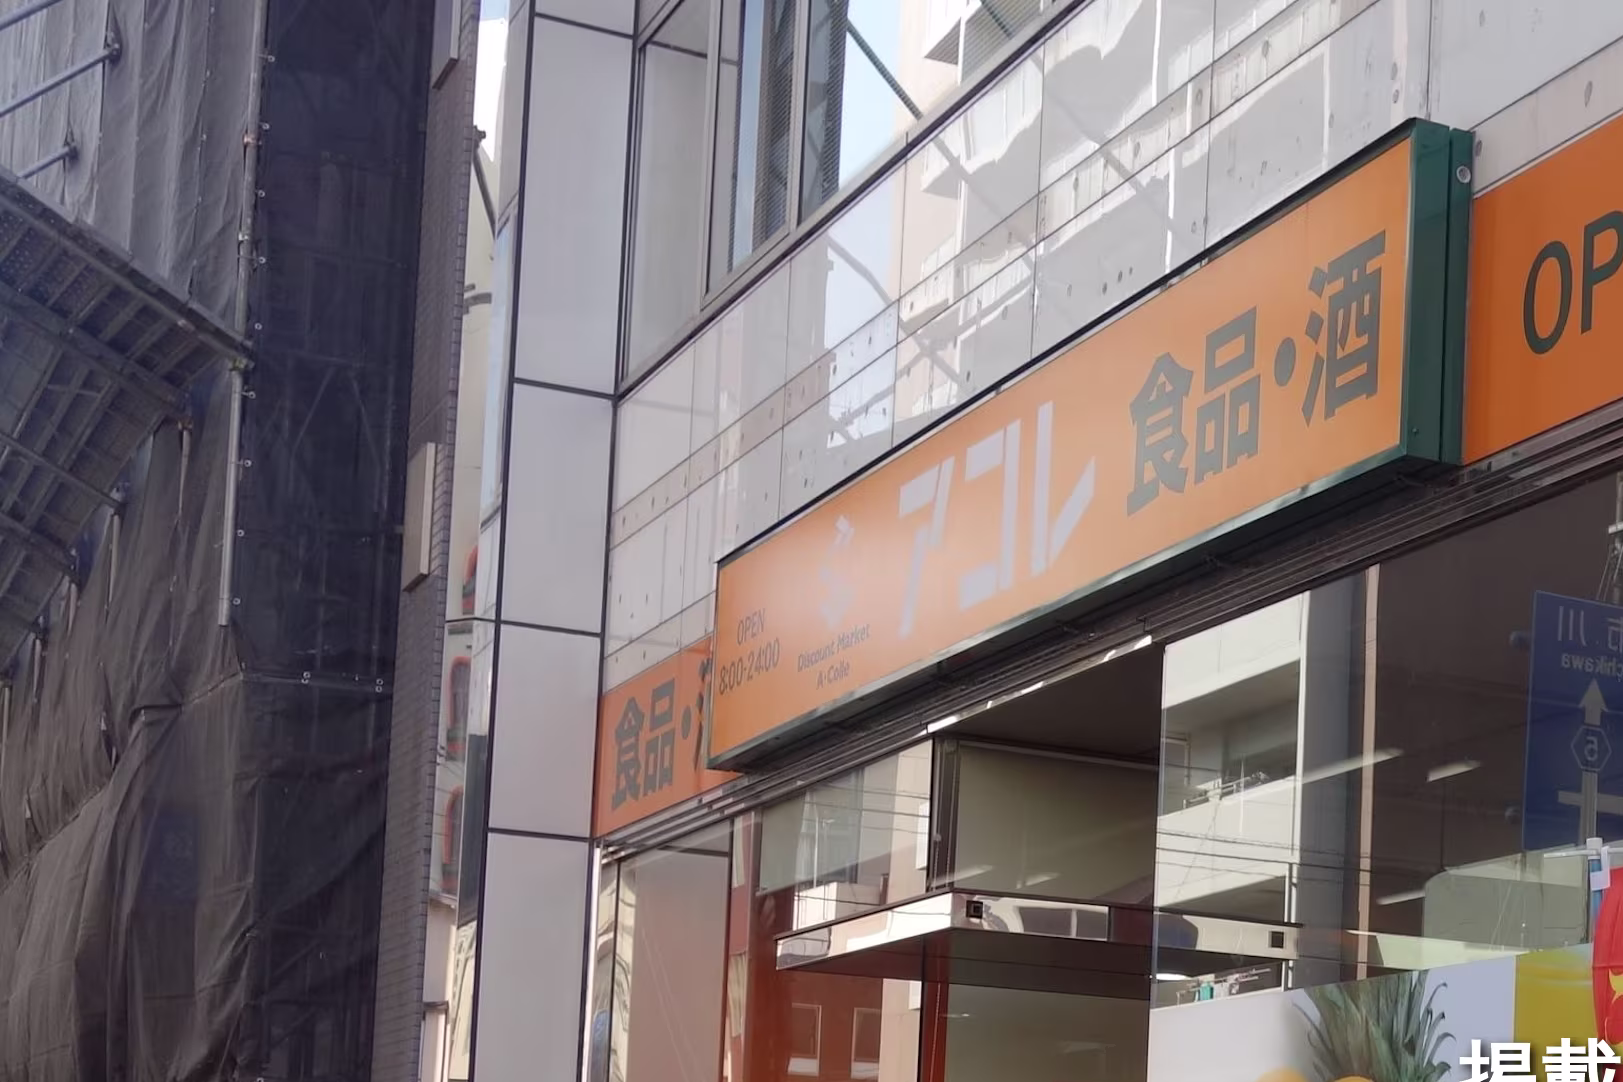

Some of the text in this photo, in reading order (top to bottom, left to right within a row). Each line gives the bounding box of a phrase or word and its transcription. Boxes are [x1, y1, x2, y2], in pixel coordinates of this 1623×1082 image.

[898, 230, 1388, 639] アコレ 食品・酒
[736, 608, 766, 646] OPEN
